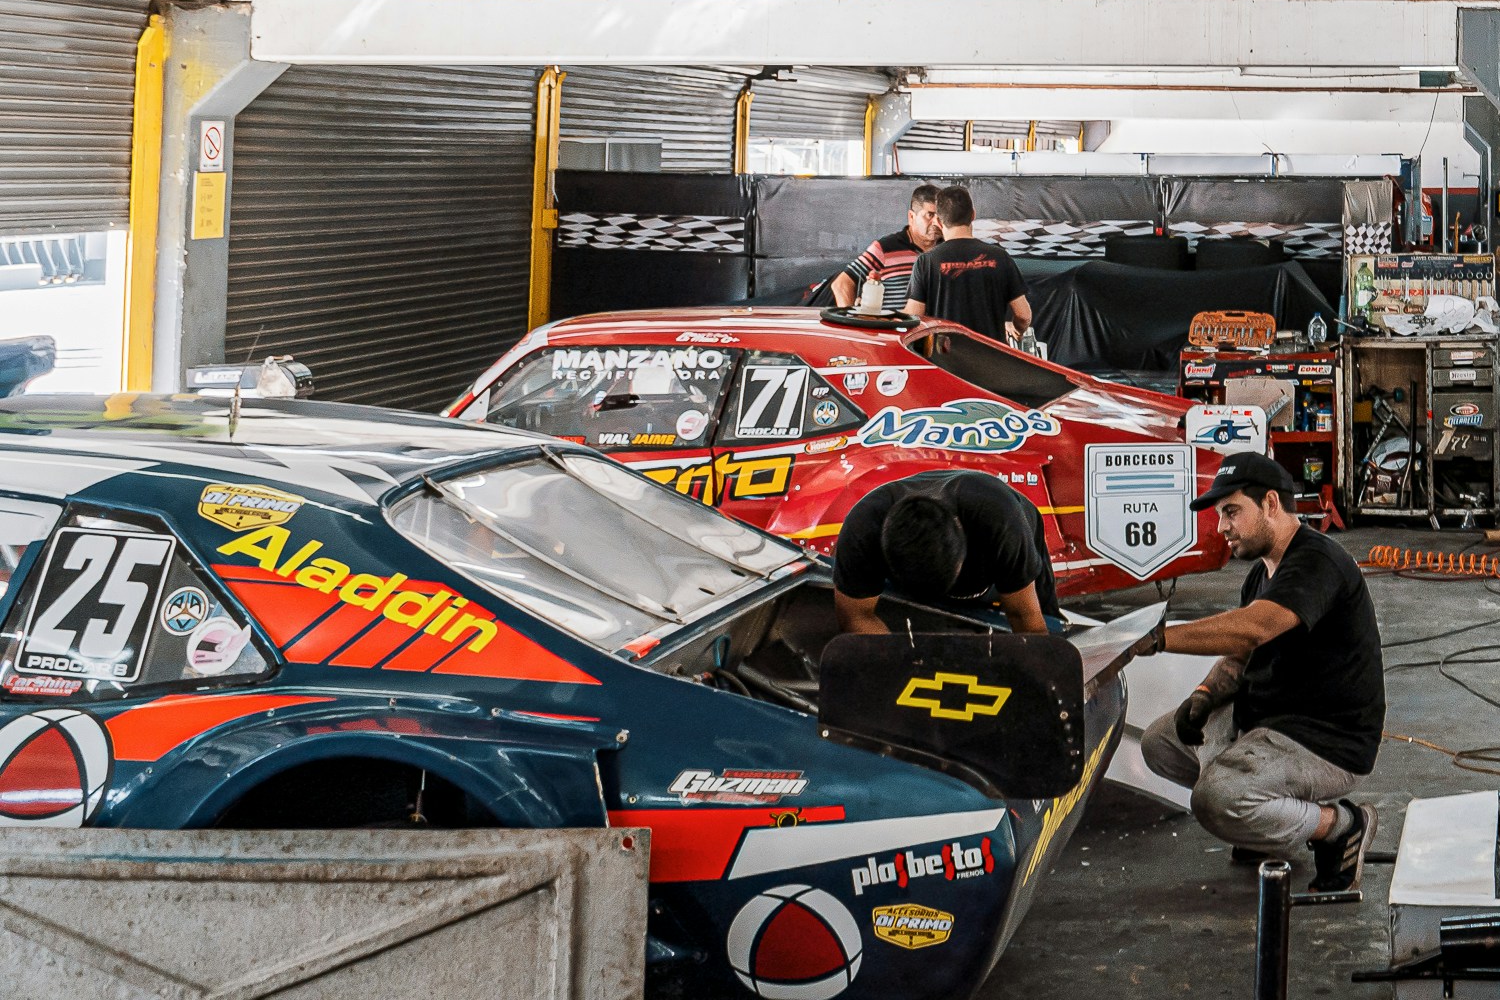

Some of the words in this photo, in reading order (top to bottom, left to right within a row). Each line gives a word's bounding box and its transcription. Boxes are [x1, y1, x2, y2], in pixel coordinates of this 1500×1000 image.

[552, 350, 723, 371] MANZANO
[552, 370, 720, 380] RECTIFIORA
[740, 369, 807, 428] 71
[738, 427, 786, 436] PROCAR
[861, 409, 1053, 446] Manaos
[599, 433, 630, 445] VIAL
[632, 433, 677, 445] JAIME
[1105, 453, 1175, 467] BORCEGOS
[226, 494, 302, 513] PRIMO
[1123, 503, 1159, 514] RUTA
[1125, 521, 1157, 547] 68
[25, 533, 170, 660] 25
[216, 523, 499, 654] Aladdin
[27, 655, 111, 675] PROCAR
[5, 674, 82, 690] CarShine
[670, 770, 808, 797] Guzman
[956, 867, 985, 880] FRENOS
[896, 916, 952, 931] PRIMO
